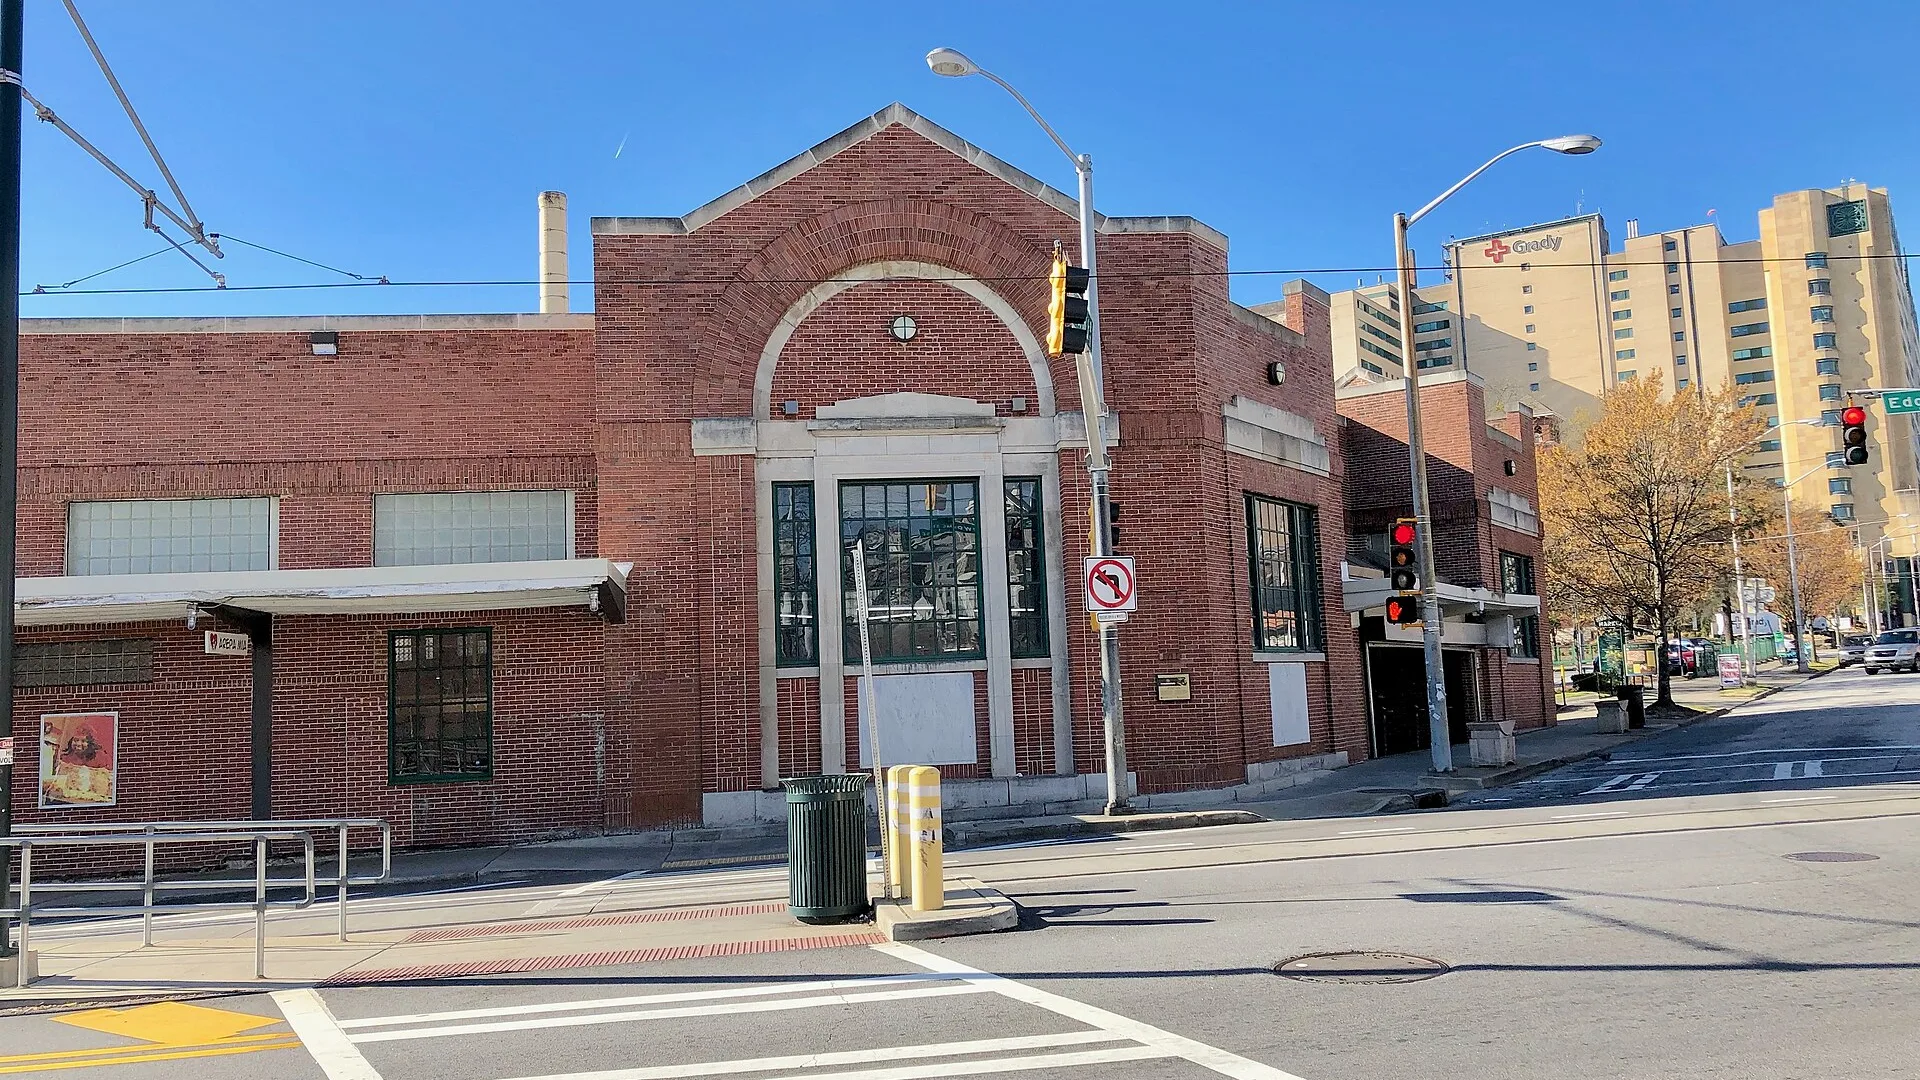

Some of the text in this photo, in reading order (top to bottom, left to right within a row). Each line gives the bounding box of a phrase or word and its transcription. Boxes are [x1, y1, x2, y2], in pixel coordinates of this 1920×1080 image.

[1512, 234, 1562, 254] Grady
[219, 637, 247, 650] AREPA MIA
[1721, 661, 1739, 669] PUBLIC
[1721, 670, 1740, 678] PARKING
